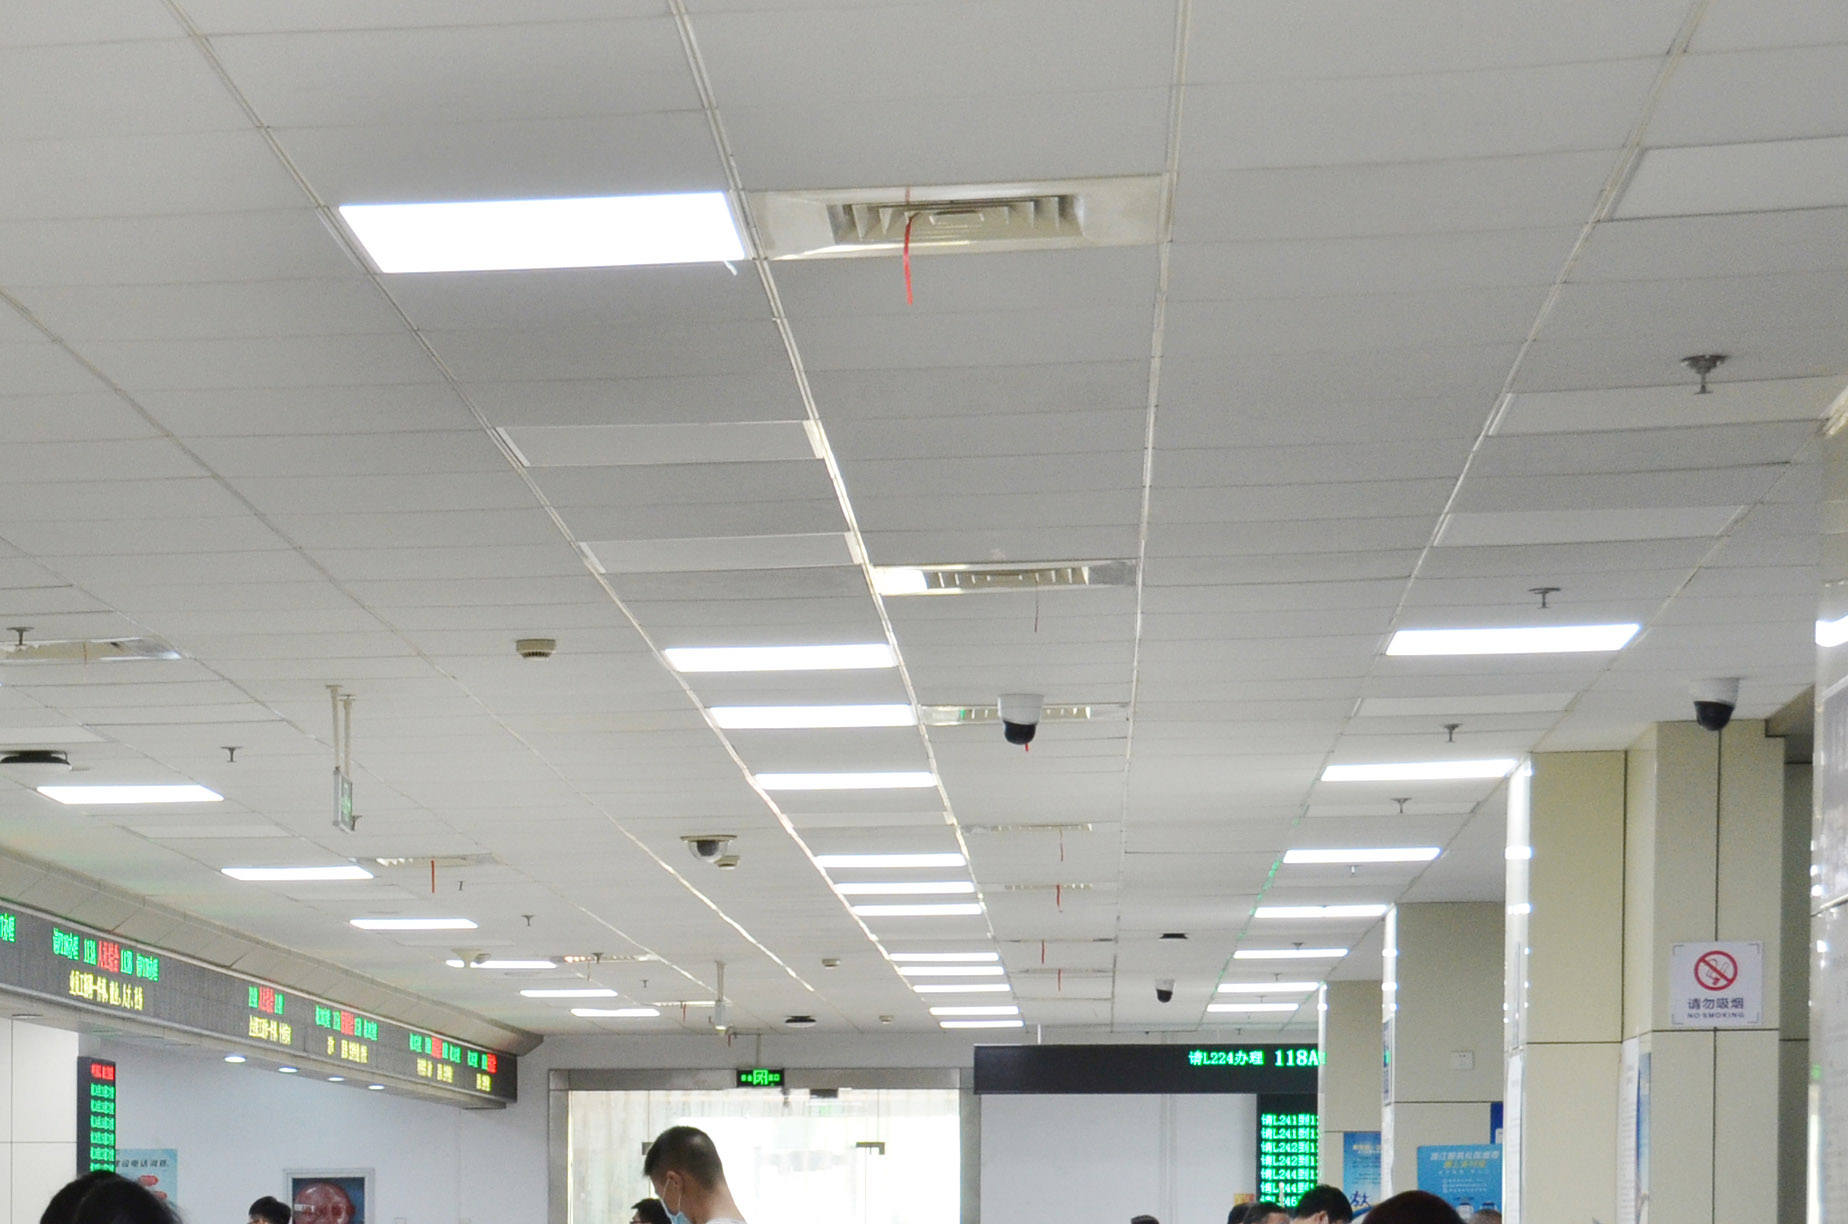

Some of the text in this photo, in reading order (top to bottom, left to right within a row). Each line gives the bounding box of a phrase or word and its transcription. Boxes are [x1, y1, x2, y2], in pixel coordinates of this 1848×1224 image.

[1688, 998, 1744, 1009] 请勿吸烟
[1188, 1049, 1319, 1067] 请L224办理 118A
